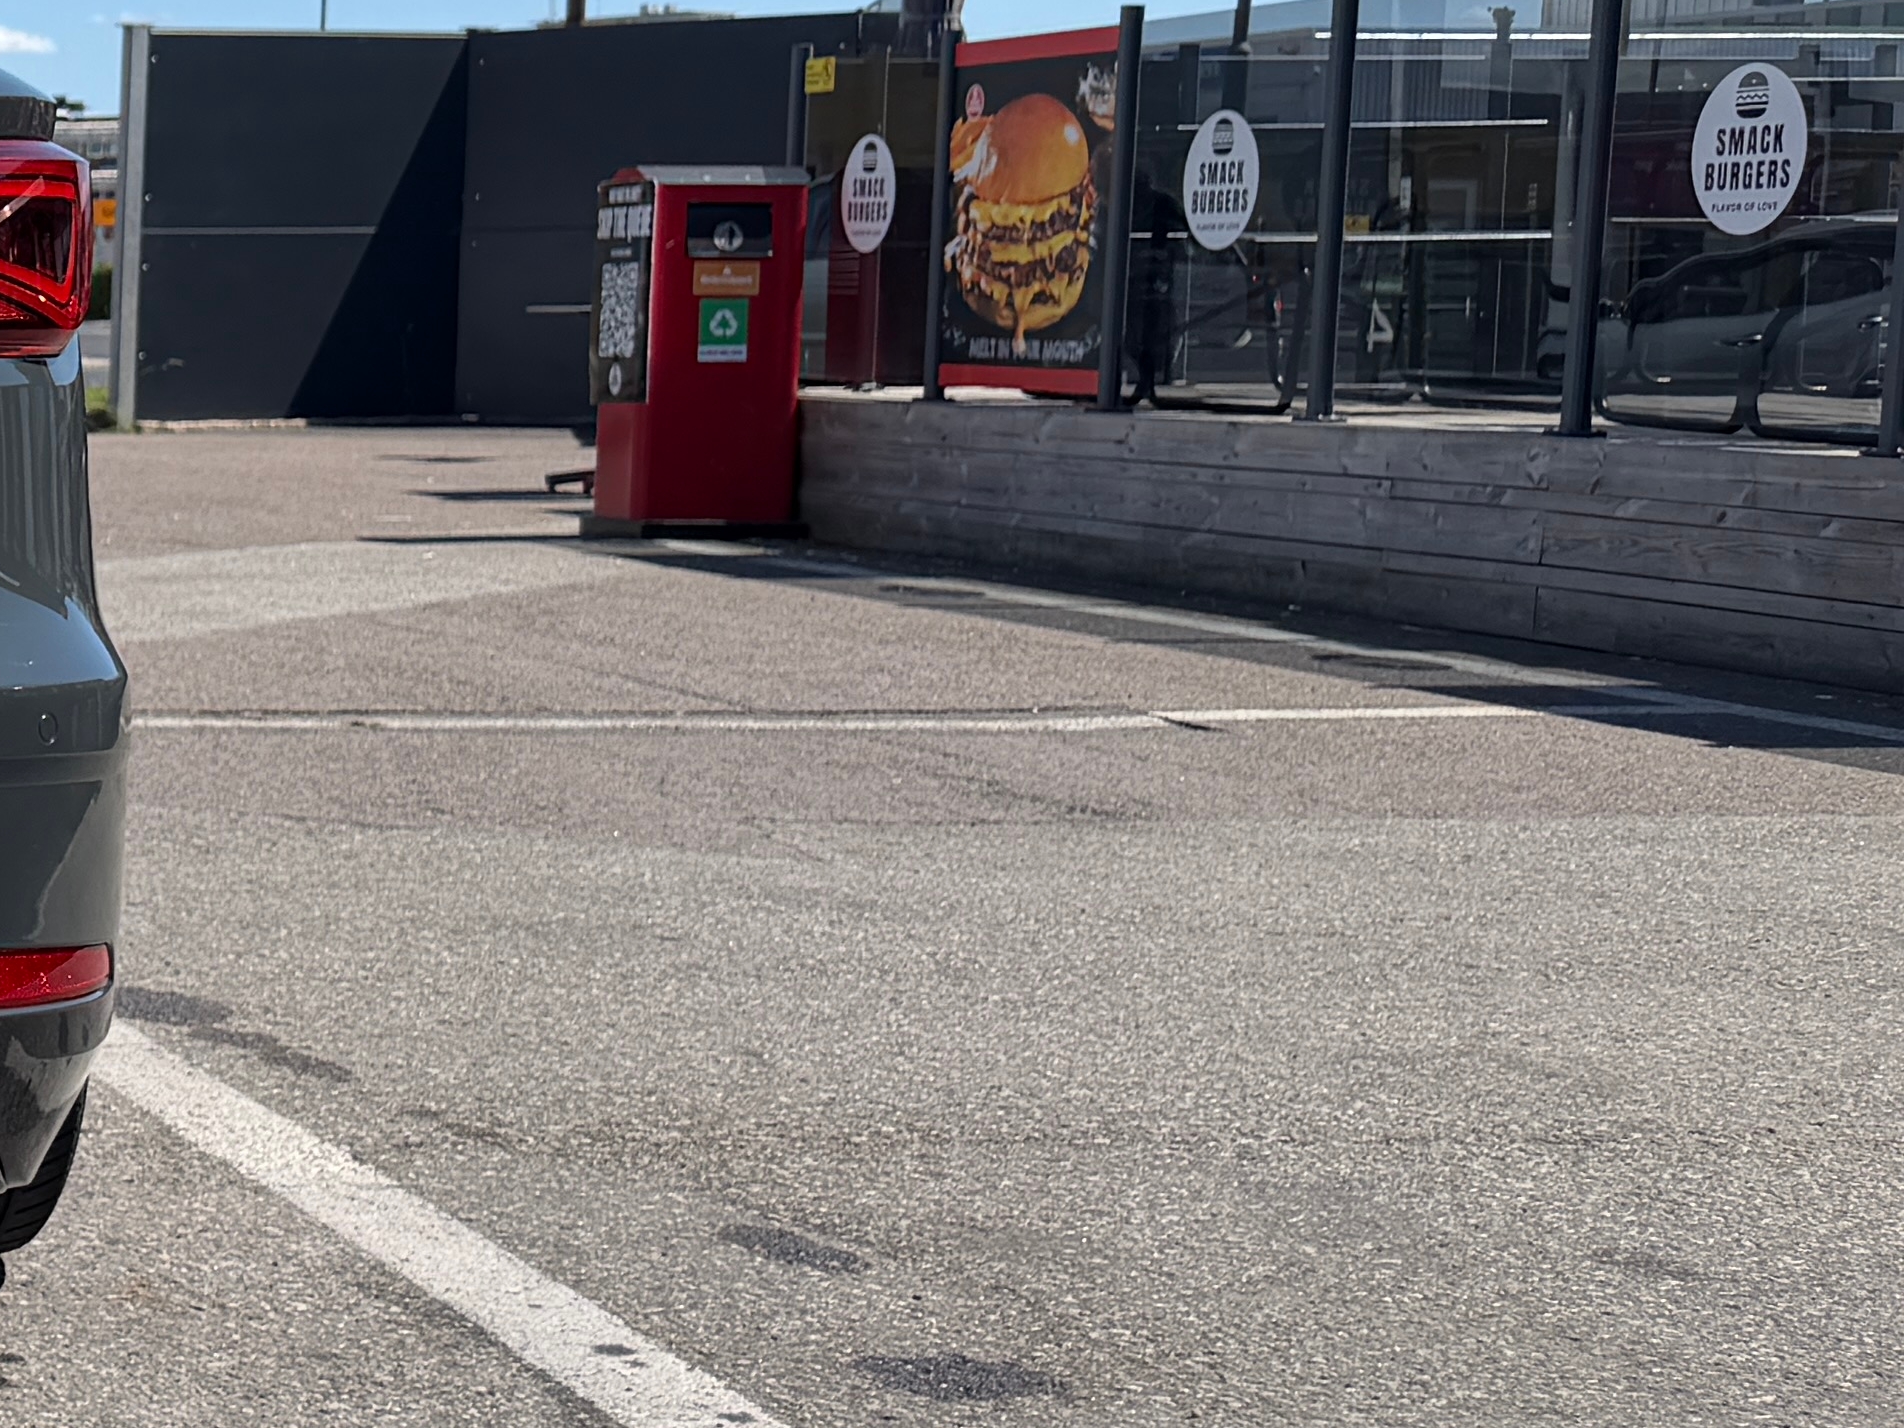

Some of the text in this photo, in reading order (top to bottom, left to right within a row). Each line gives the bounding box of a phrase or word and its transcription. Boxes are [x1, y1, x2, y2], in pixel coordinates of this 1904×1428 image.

[1715, 123, 1785, 157] SMACK
[1199, 160, 1245, 186] SMACK
[1703, 158, 1791, 192] BURGERS
[1191, 188, 1249, 214] BURGERS
[1743, 202, 1755, 212] OF
[1757, 200, 1778, 211] LOVE
